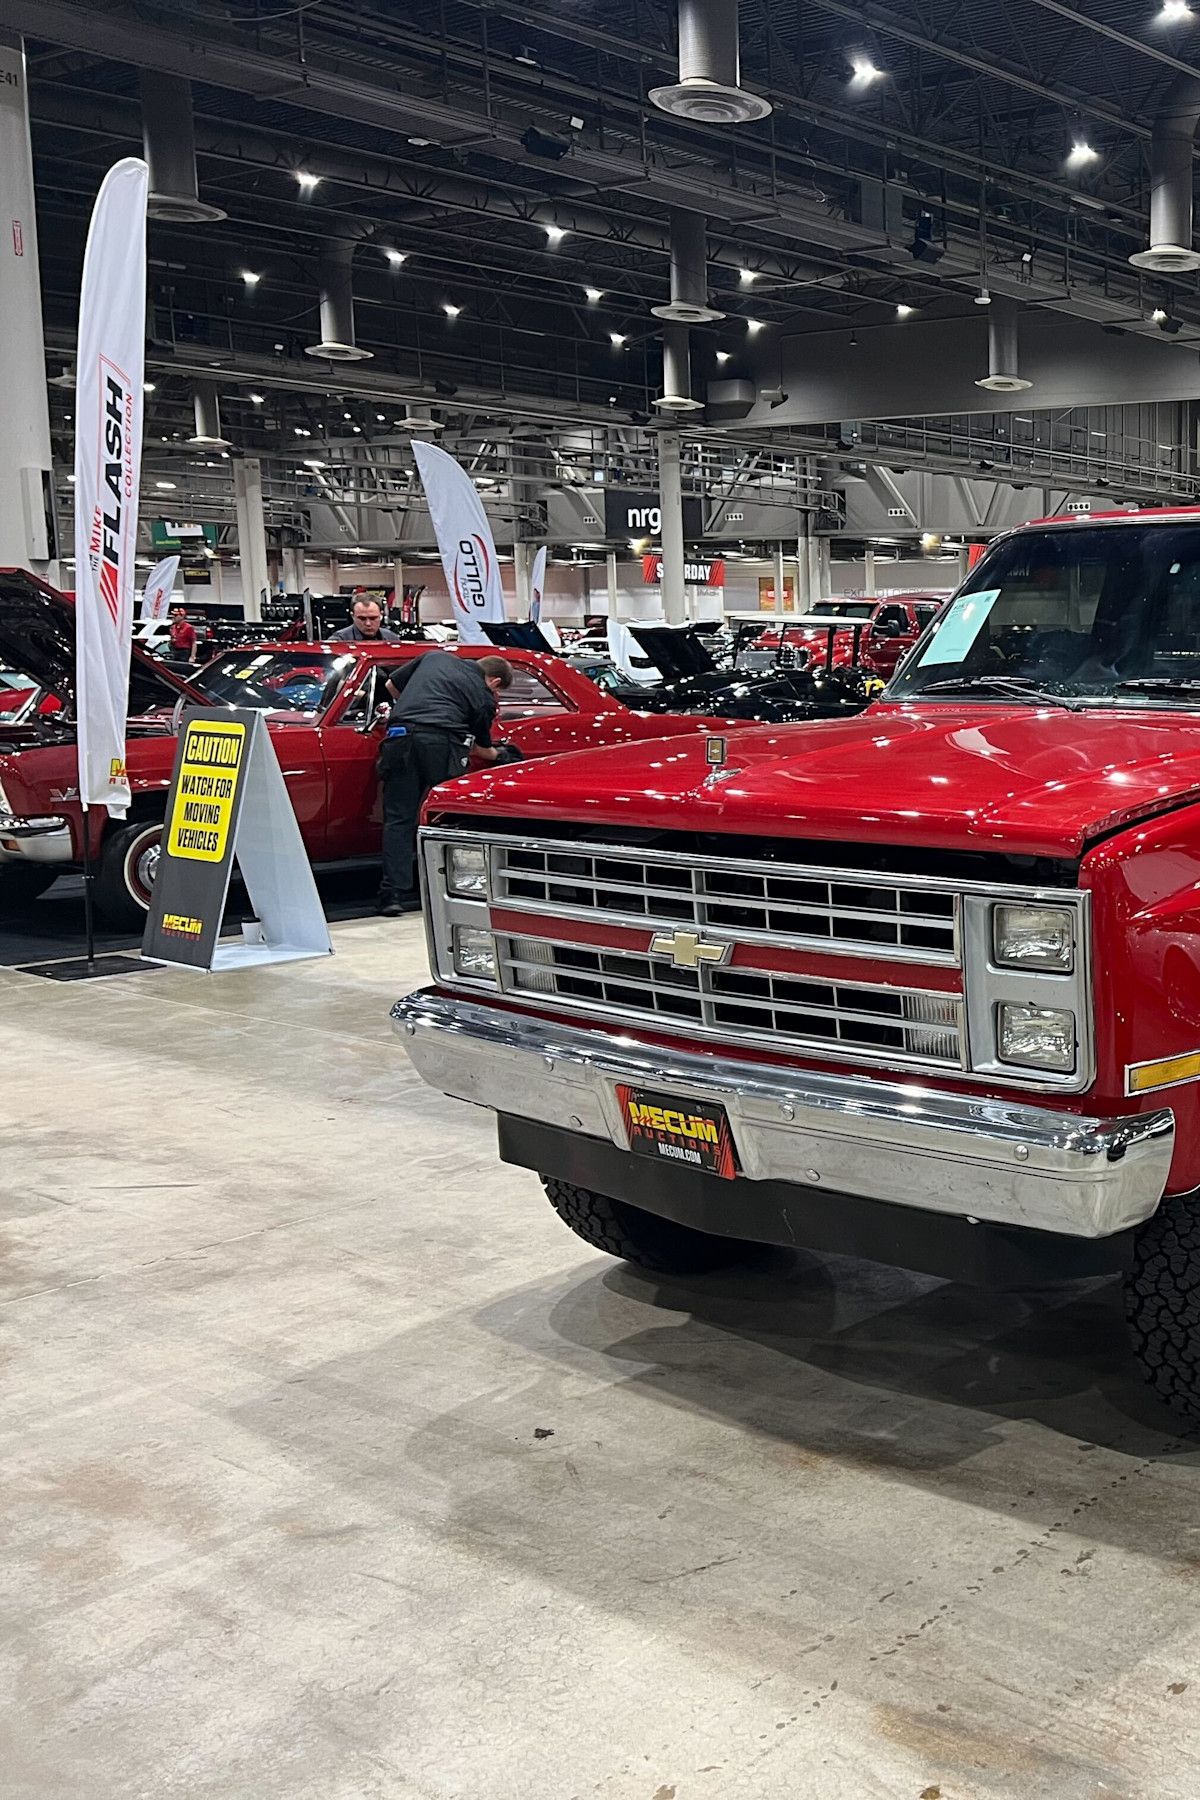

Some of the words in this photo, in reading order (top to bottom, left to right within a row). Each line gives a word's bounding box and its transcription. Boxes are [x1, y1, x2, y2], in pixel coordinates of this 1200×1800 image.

[125, 392, 133, 498] COLLECTION
[103, 375, 123, 565] FLASH
[89, 505, 102, 553] MIKE
[627, 507, 661, 535] nrg
[459, 540, 485, 607] GULLO
[656, 562, 711, 581] SRDAY
[187, 735, 240, 764] CAUTION
[182, 775, 214, 797] WATCH
[214, 778, 233, 799] FOR
[184, 802, 221, 824] MOVING
[177, 828, 219, 852] VEHICLES
[162, 913, 203, 934] MECUM
[628, 1102, 719, 1144] MECUM
[633, 1126, 721, 1156] AUCTIONS
[658, 1142, 702, 1165] MECUM.COM
